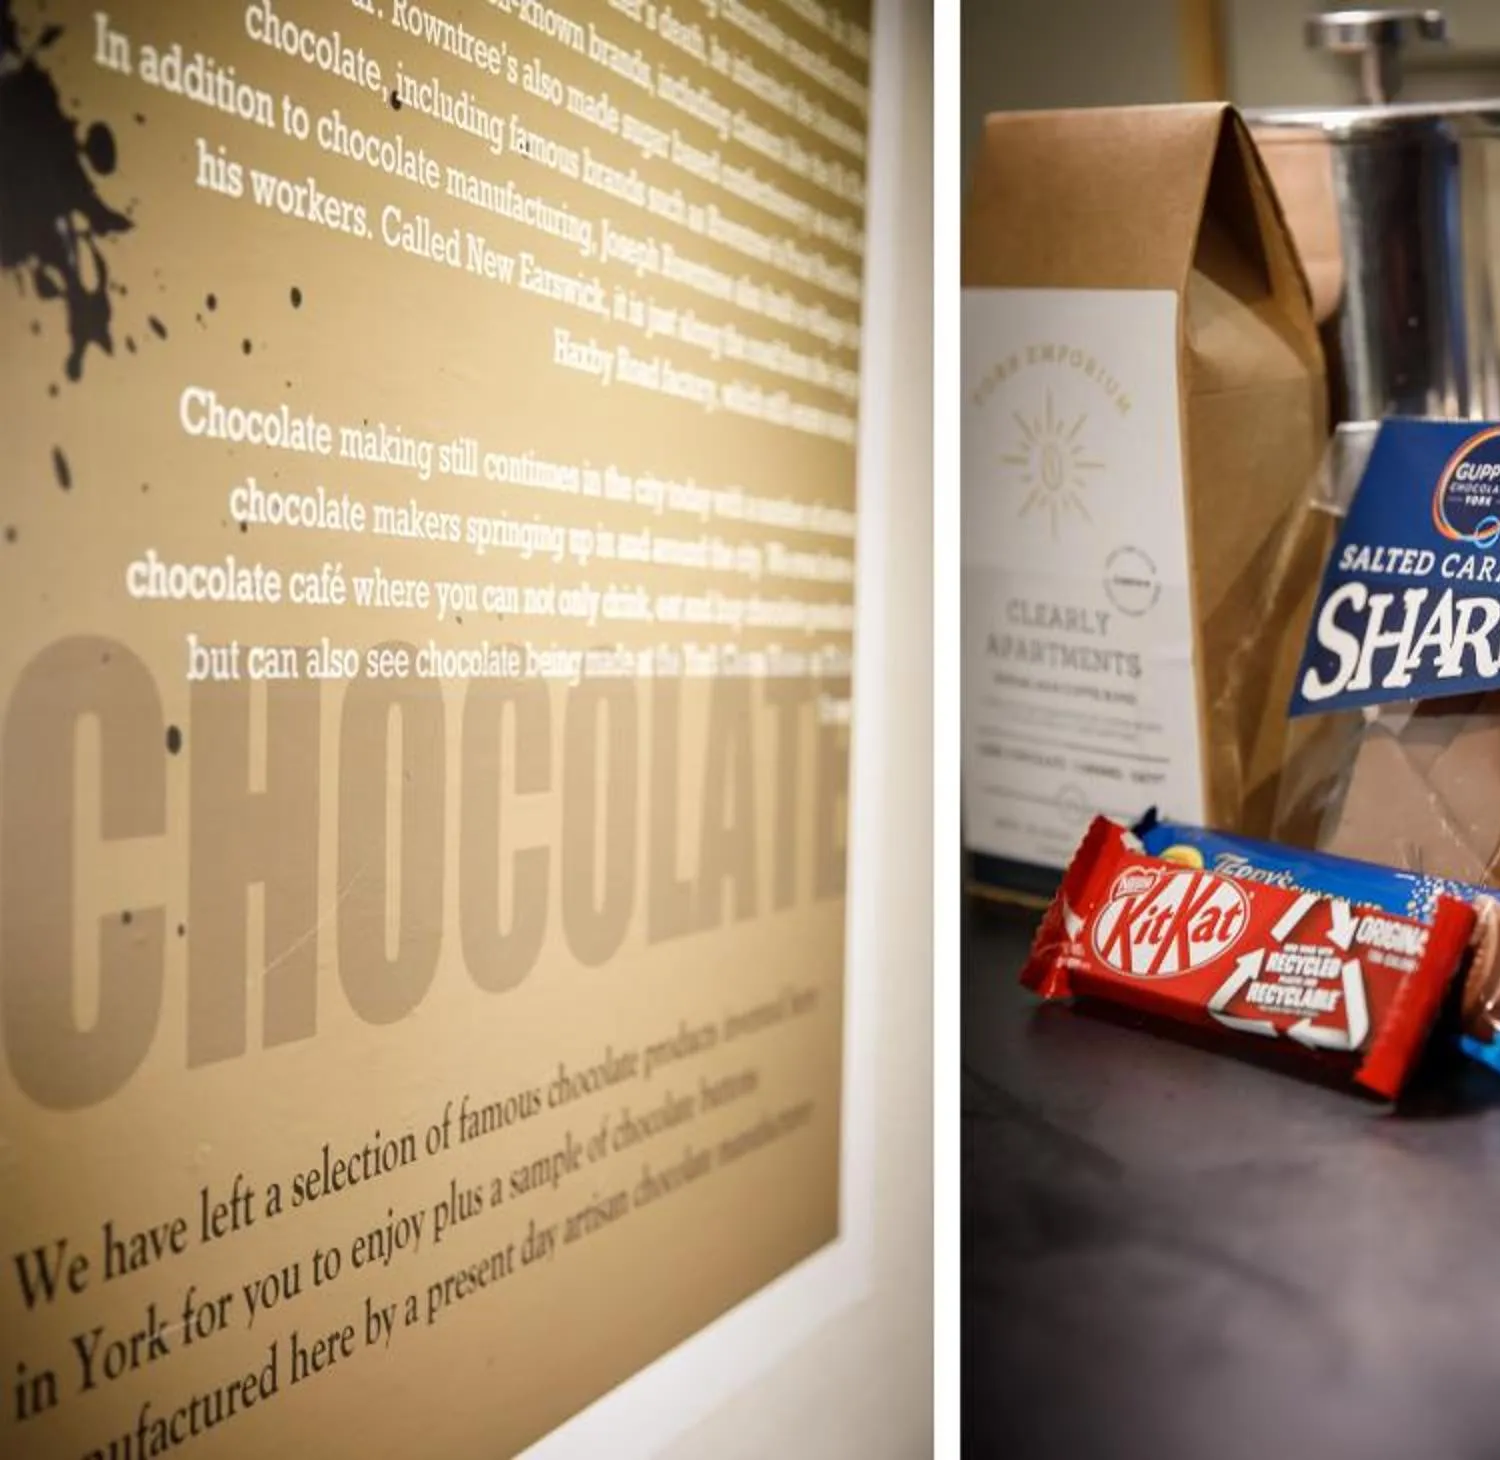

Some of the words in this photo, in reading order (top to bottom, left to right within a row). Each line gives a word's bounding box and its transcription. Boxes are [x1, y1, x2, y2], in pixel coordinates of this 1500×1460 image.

[245, 0, 391, 108] chocolate,
[396, 60, 505, 155] including
[509, 113, 578, 178] famous
[392, 0, 518, 84] Rowntree's
[523, 58, 563, 106] also
[566, 85, 619, 134] made
[94, 12, 132, 75] In
[139, 42, 275, 129] addition
[281, 95, 310, 141] to
[317, 110, 441, 189] chocolate
[446, 166, 598, 257] manufacturing,
[195, 138, 243, 198] his
[250, 169, 374, 240] workers.
[381, 205, 461, 268] Called
[466, 232, 515, 285] New
[180, 385, 333, 455] Chocolate
[340, 422, 433, 481] making
[439, 436, 478, 478] still
[483, 449, 580, 494] continues
[229, 477, 366, 532] chocolate
[373, 500, 461, 542] makers
[466, 508, 565, 562] springing
[1465, 495, 1492, 507] YORK
[126, 547, 282, 603] chocolate
[289, 562, 348, 605] café
[352, 566, 430, 610] where
[435, 579, 478, 621] you
[482, 584, 519, 614] can
[524, 582, 556, 615] not
[1338, 543, 1435, 576] SALTED
[186, 632, 240, 680] but
[247, 646, 299, 680] can
[306, 636, 360, 679] also
[366, 648, 411, 678] see
[416, 639, 520, 678] chocolate
[525, 641, 584, 686] being
[985, 632, 1143, 680] APARTMENTS
[1005, 598, 1110, 637] CLEARLY
[3, 634, 848, 1112] CHOCOLATE
[1100, 871, 1243, 976] KitKat
[1265, 951, 1343, 979] RECYCLED
[13, 1238, 90, 1312] We
[101, 1219, 188, 1283] have
[200, 1173, 257, 1244] left
[265, 1181, 283, 1218] a
[291, 1129, 418, 1208] selection
[425, 1101, 454, 1156] of
[458, 1085, 543, 1146] famous
[546, 1043, 641, 1110] chocolate
[14, 1360, 59, 1422] in
[71, 1303, 171, 1393] York
[181, 1285, 234, 1348] for
[243, 1260, 302, 1331] you
[312, 1246, 342, 1287] to
[352, 1205, 427, 1266] enjoy
[432, 1177, 484, 1243] plus
[490, 1177, 504, 1208] a
[508, 1130, 583, 1198] sample
[586, 1113, 612, 1165] of
[289, 1330, 356, 1385] here
[364, 1296, 398, 1350] by
[404, 1294, 420, 1327] a
[425, 1236, 517, 1322] present
[520, 1218, 558, 1267] day
